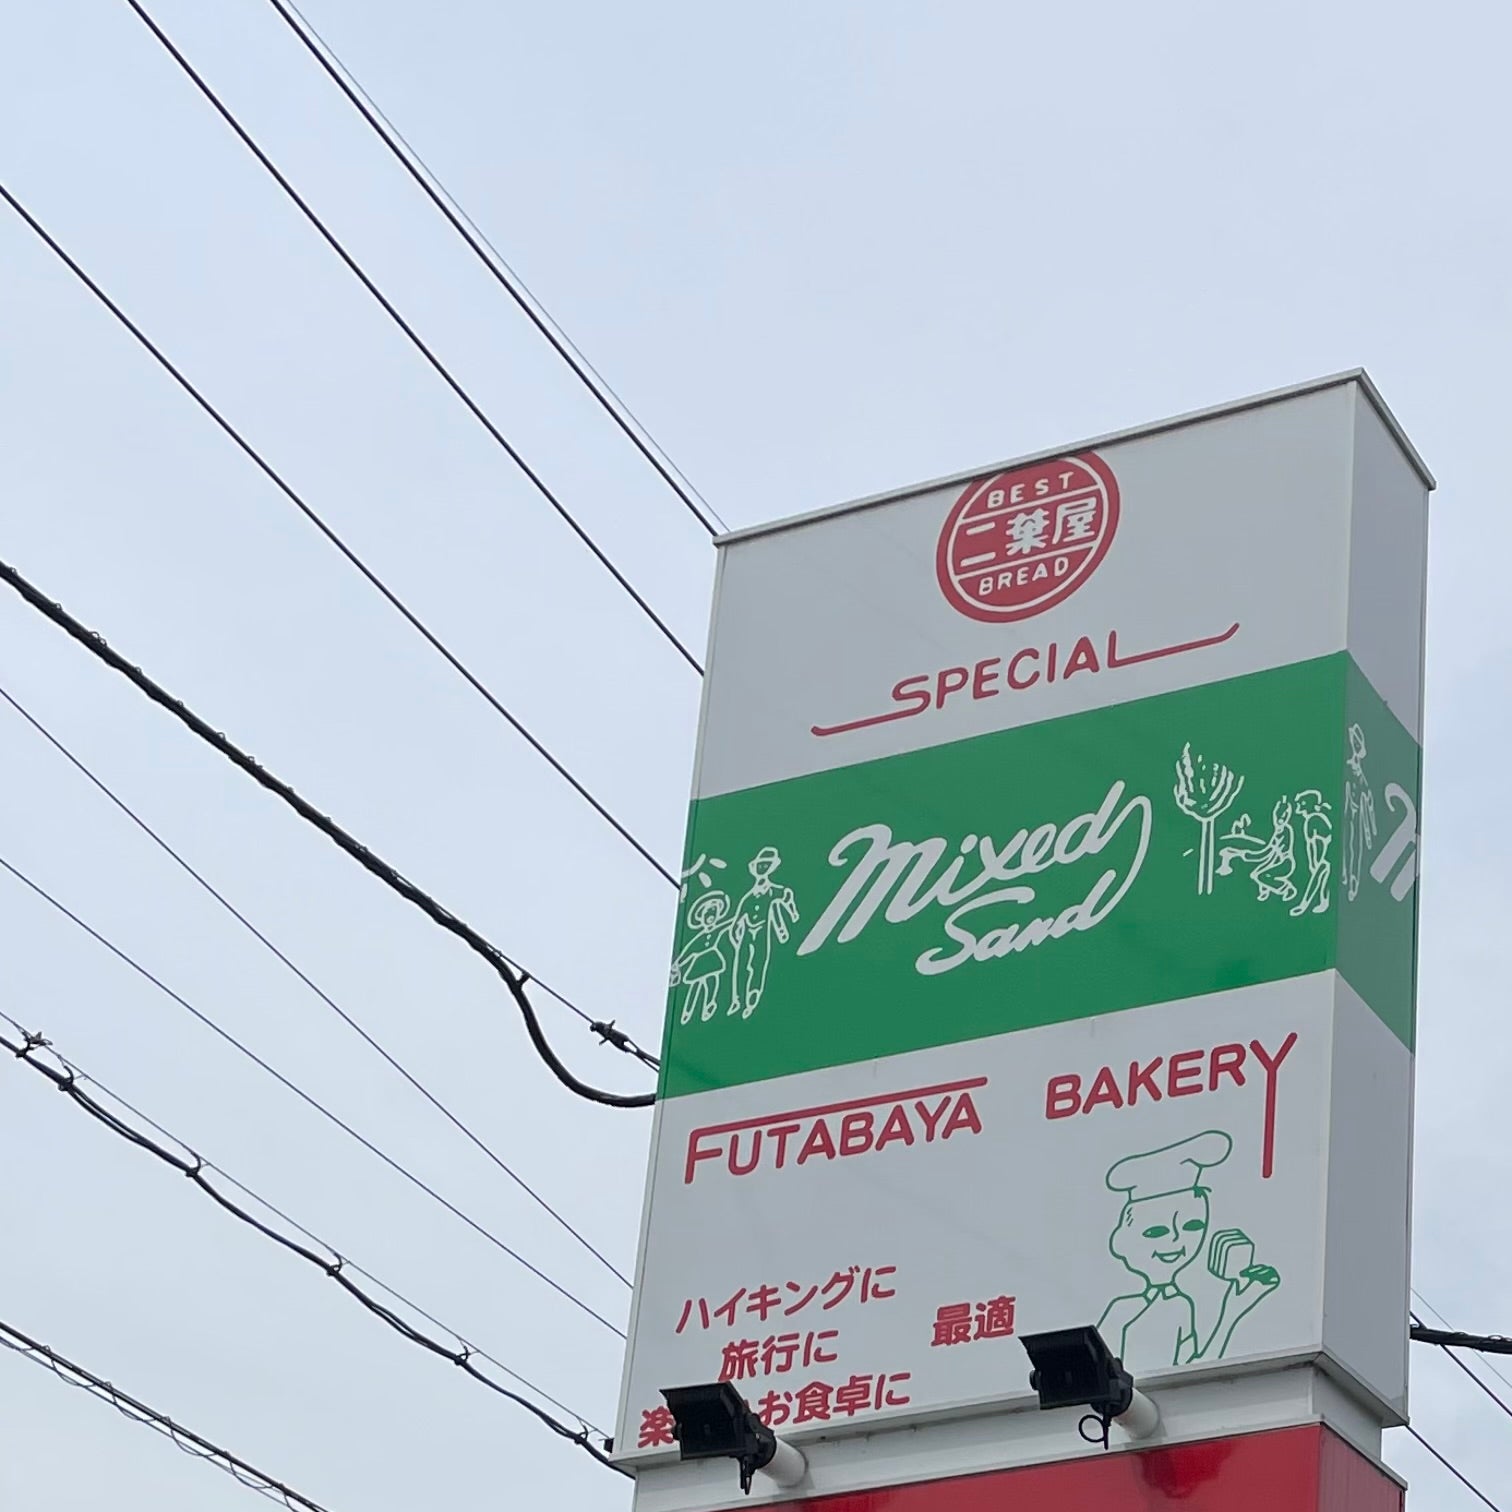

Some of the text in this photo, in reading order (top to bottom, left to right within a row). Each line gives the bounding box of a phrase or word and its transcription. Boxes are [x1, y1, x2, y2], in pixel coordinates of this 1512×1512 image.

[986, 470, 1074, 509] BEST
[978, 556, 1069, 596] BREAD
[811, 622, 1240, 736] SPECIAL
[914, 868, 1118, 976] Sand
[684, 1077, 989, 1184] FUTABAYA
[1045, 1032, 1298, 1178] BAKERY
[675, 1265, 897, 1334] ハイキングに
[930, 1295, 1016, 1347] 最適
[718, 1329, 839, 1382] 旅行に
